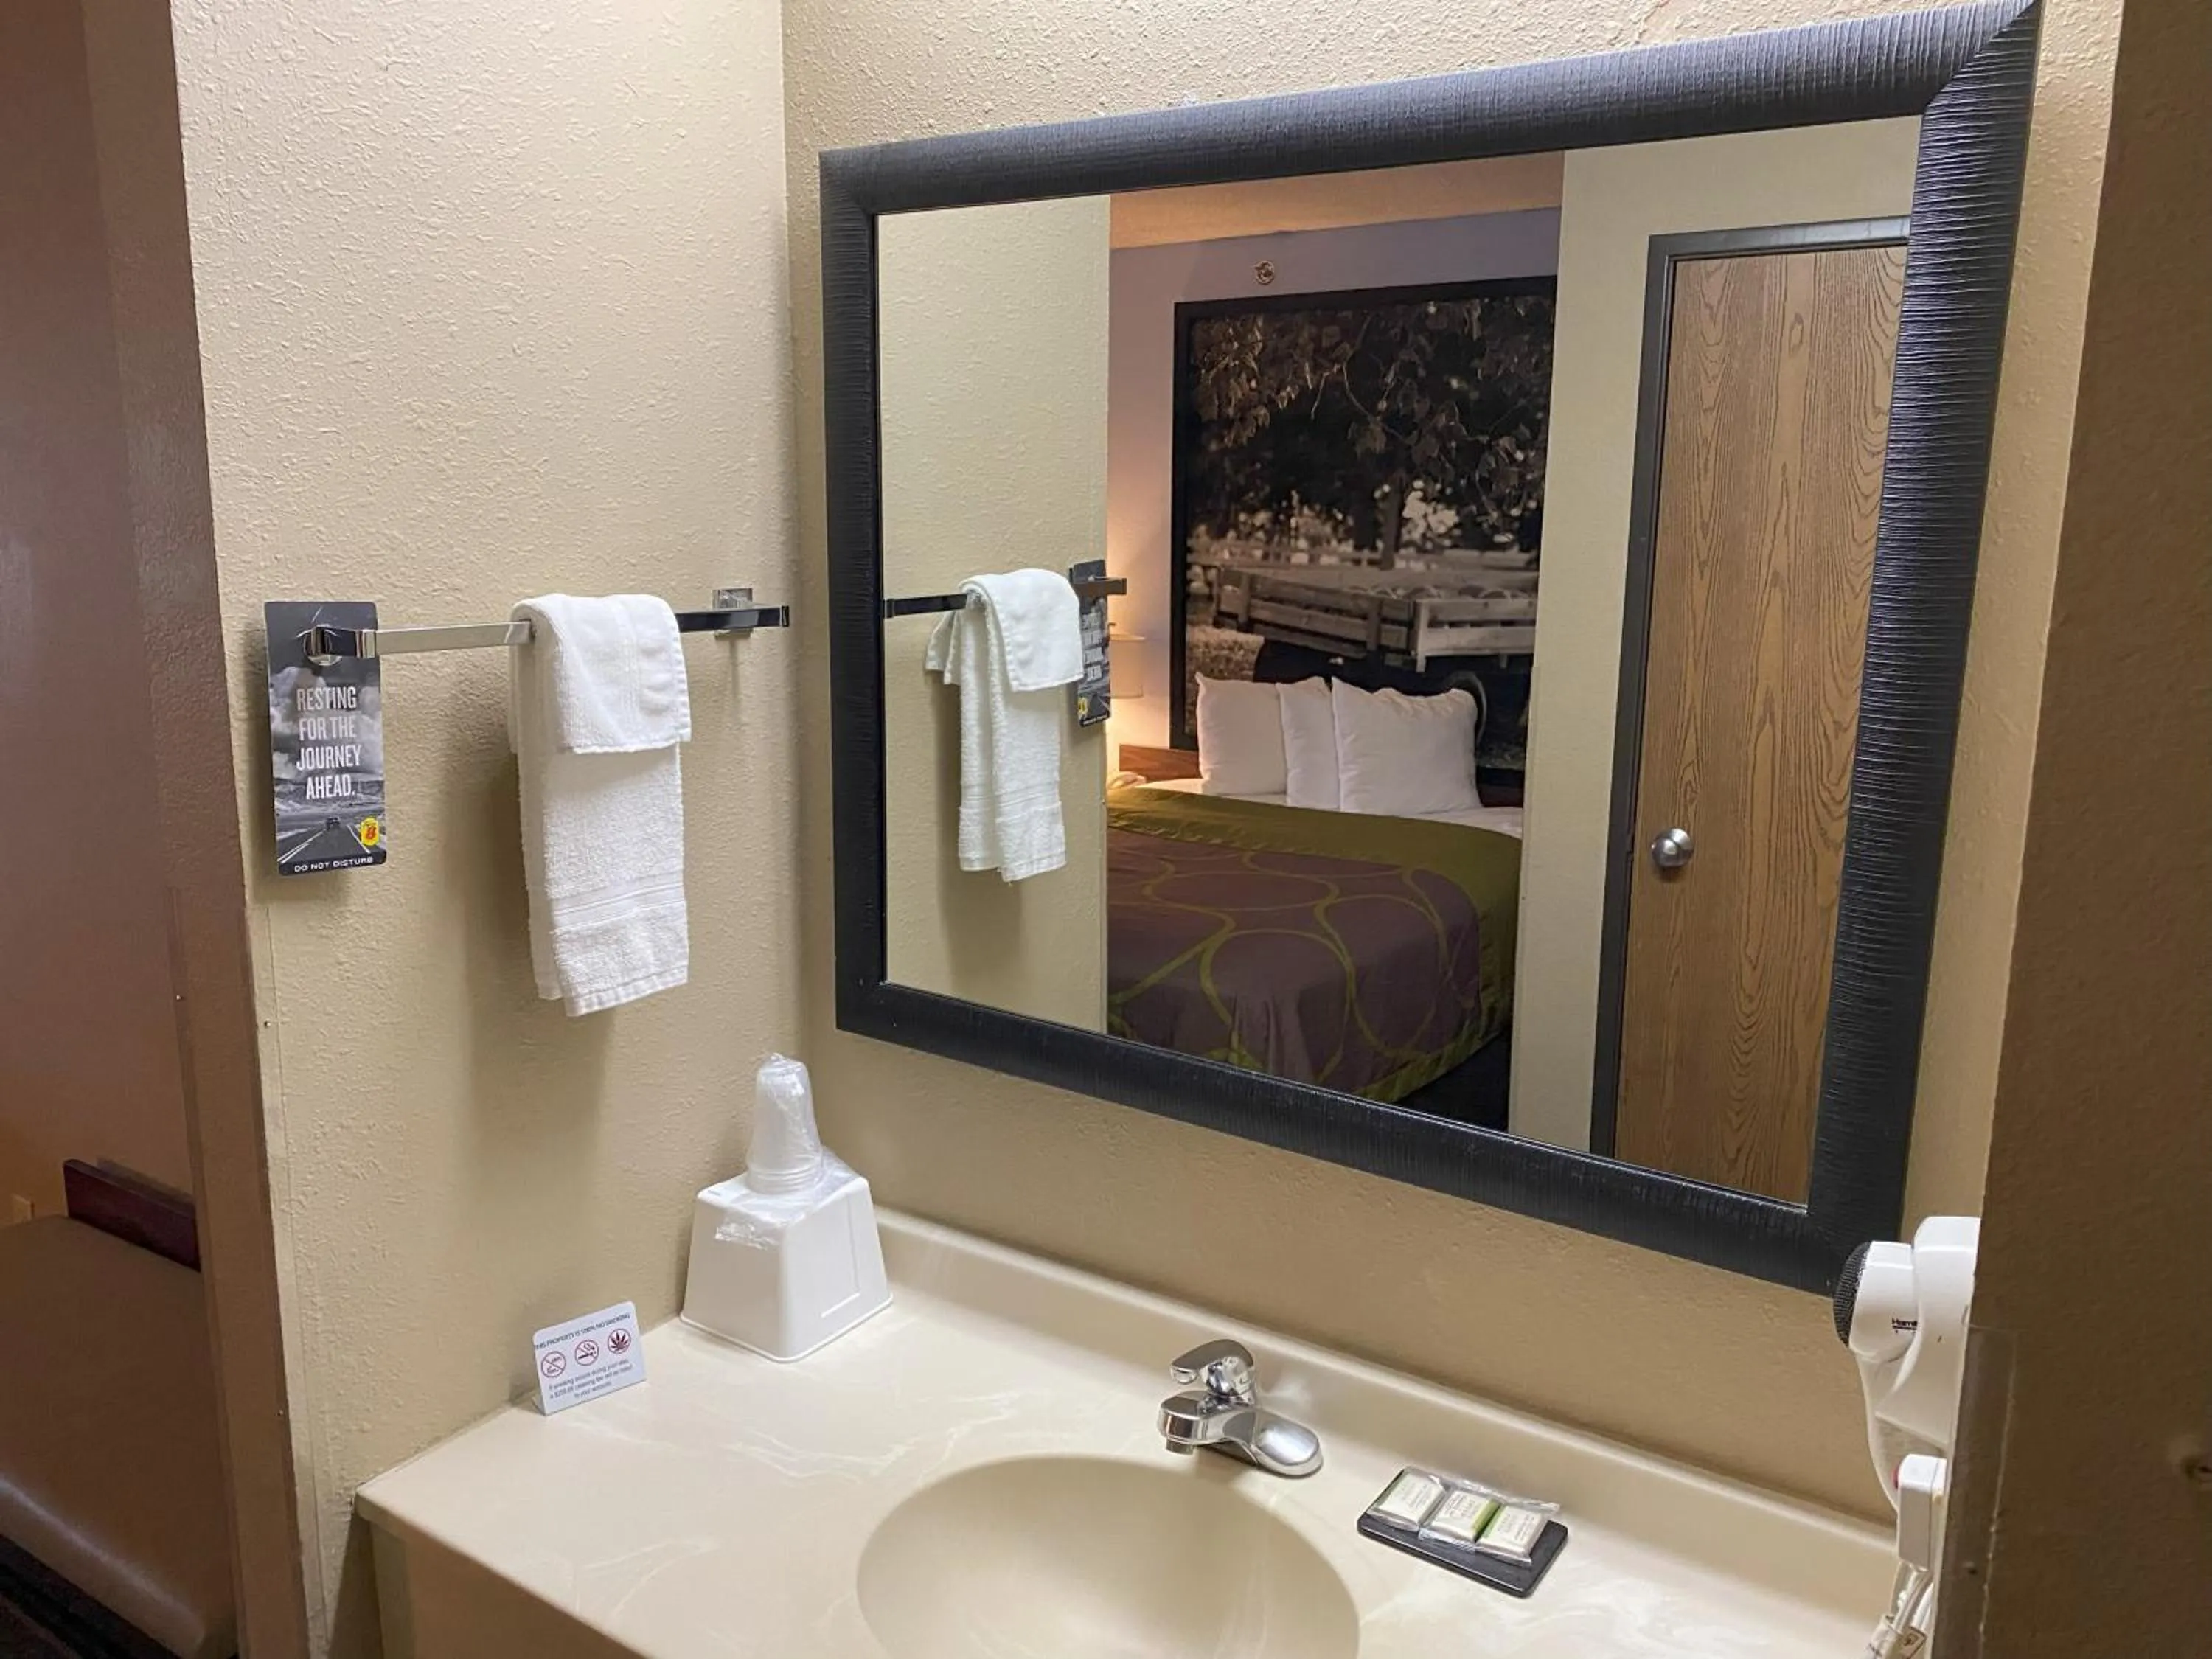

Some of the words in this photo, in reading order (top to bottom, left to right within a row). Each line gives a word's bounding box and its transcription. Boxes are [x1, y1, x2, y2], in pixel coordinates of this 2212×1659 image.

[296, 686, 357, 712] RESTING
[299, 717, 327, 741] FOR
[329, 715, 357, 740] THE
[296, 744, 361, 771] JOURNEY
[306, 773, 355, 800] AHEAD.
[294, 864, 307, 872] DO
[310, 861, 330, 870] NOT
[333, 855, 373, 868] DISTURB
